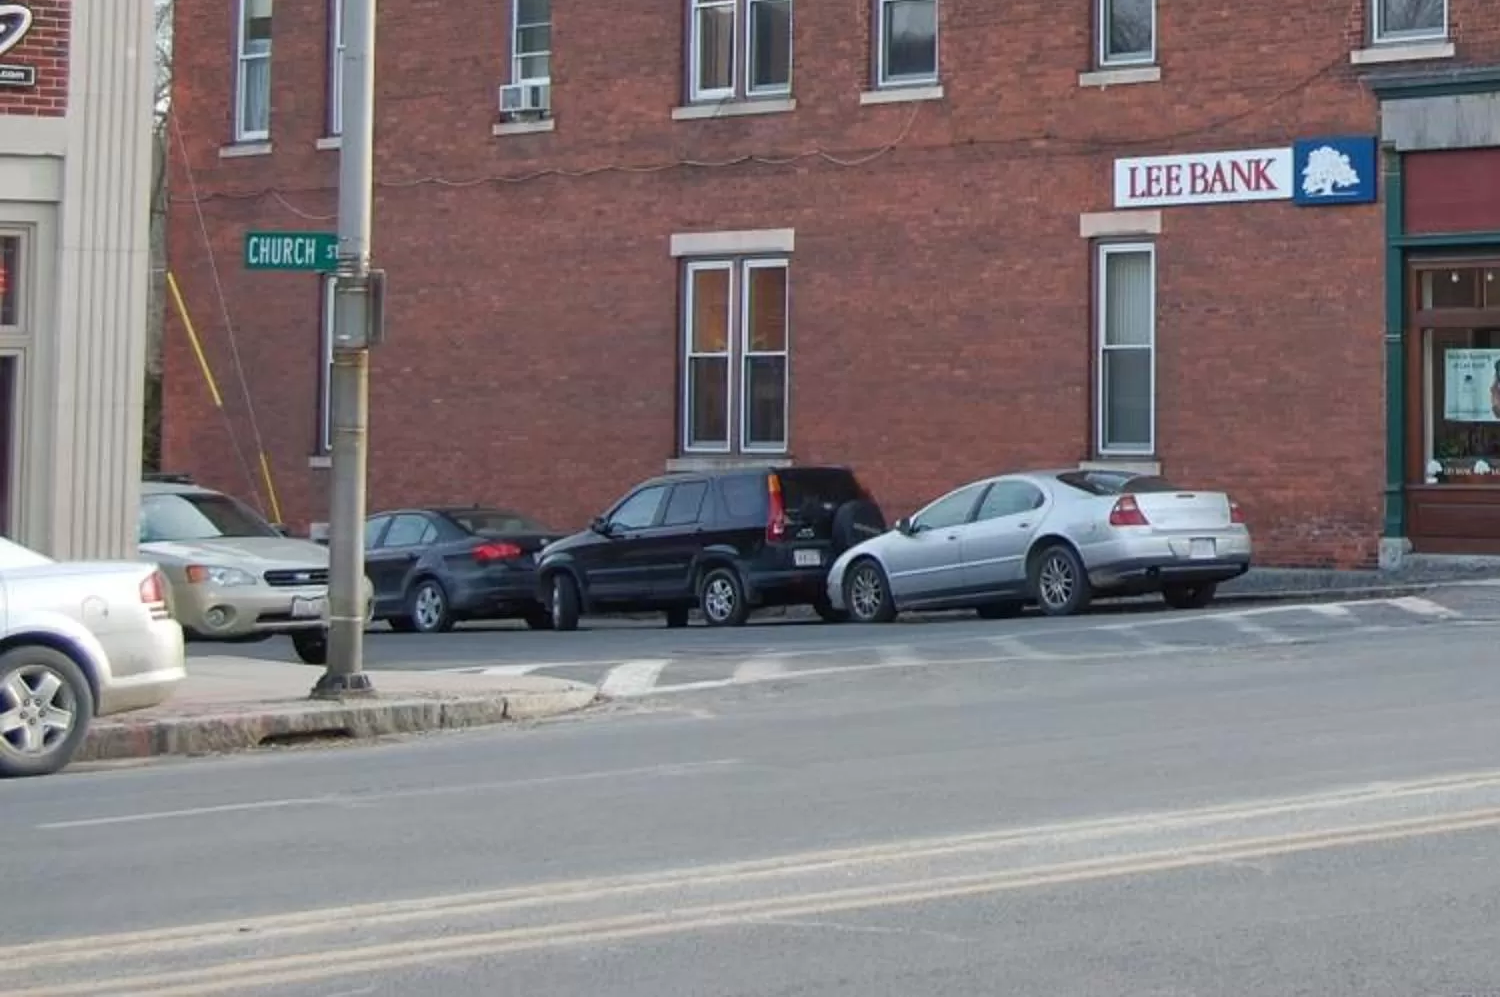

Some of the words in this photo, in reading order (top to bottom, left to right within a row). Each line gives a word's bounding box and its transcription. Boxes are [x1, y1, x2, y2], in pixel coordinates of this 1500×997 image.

[1128, 164, 1182, 199] LEE
[1189, 158, 1278, 196] BANK
[248, 236, 317, 265] CHURCH
